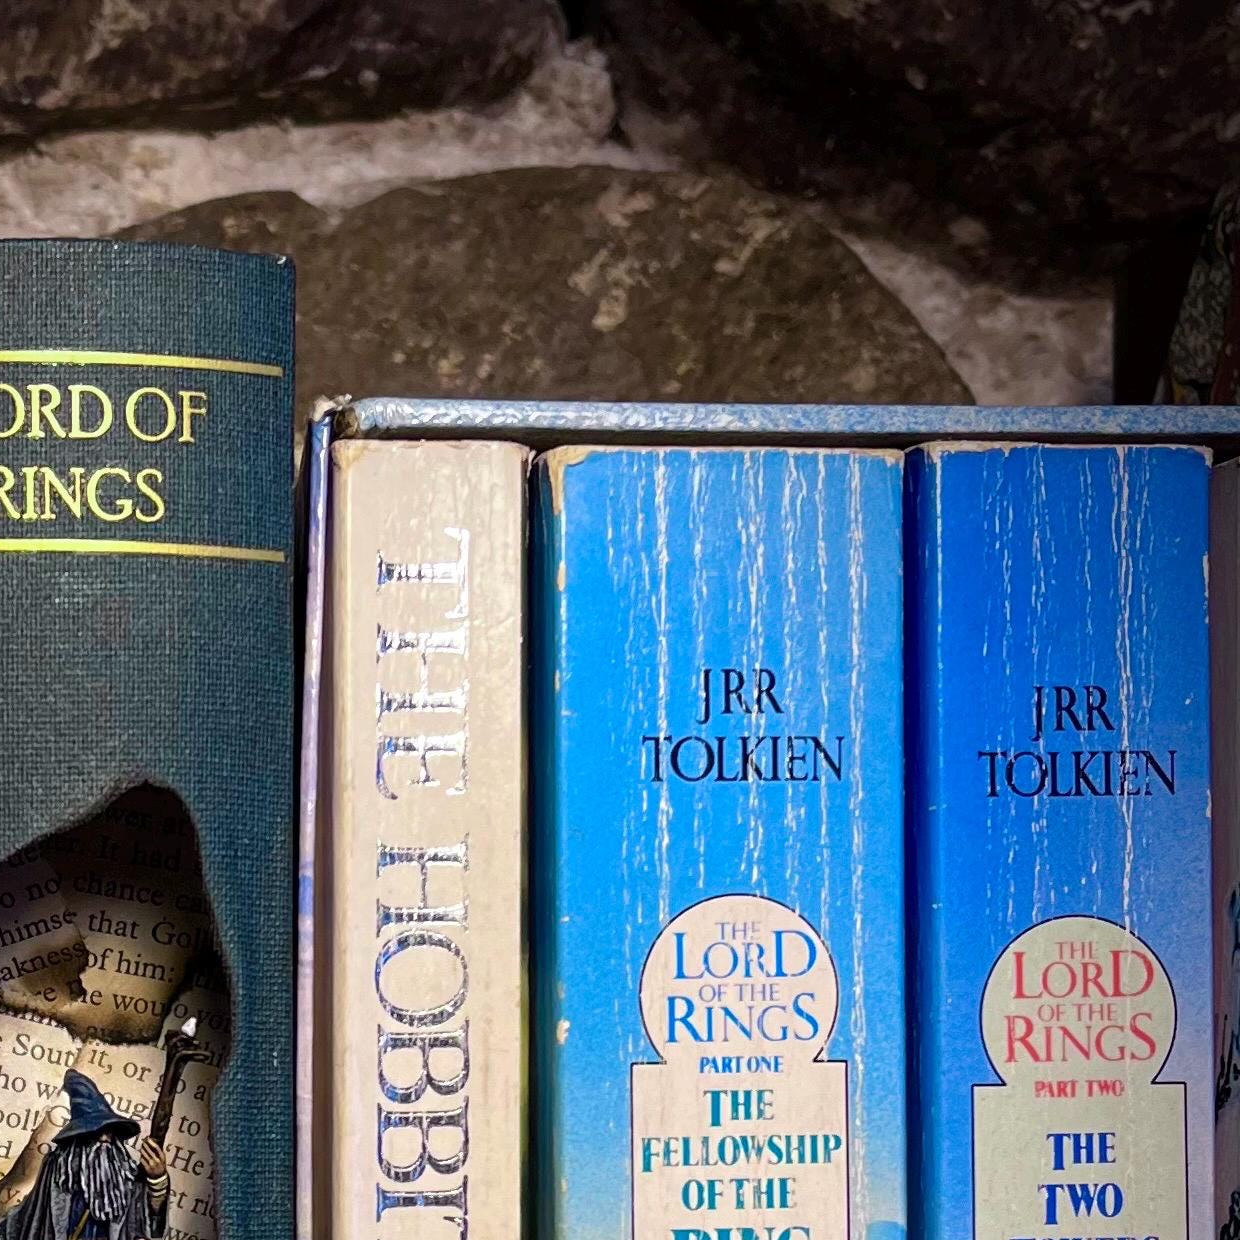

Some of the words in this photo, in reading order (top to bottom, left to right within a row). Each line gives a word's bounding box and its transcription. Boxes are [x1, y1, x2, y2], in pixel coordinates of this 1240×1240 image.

[125, 387, 208, 443] OF
[376, 527, 471, 800] THE
[696, 667, 784, 725] JRR
[1031, 684, 1115, 742] JRR
[642, 735, 845, 782] TOLKIEN
[977, 750, 1177, 798] TOLKIEN
[88, 910, 140, 940] that
[714, 920, 762, 942] THE
[115, 951, 175, 983] him:
[672, 929, 817, 981] LORD
[1055, 941, 1098, 961] THE
[698, 983, 725, 1003] OF
[732, 983, 781, 1002] THE
[1010, 949, 1155, 999] LORD
[665, 992, 821, 1045] RINGS
[1038, 1002, 1065, 1023] OF
[1070, 1002, 1117, 1022] THE
[1003, 1012, 1157, 1064] RINGS
[123, 1061, 152, 1083] or
[698, 1055, 745, 1075] PART
[748, 1055, 784, 1073] ONE
[703, 1089, 774, 1128] THE
[1034, 1081, 1080, 1098] PART
[1085, 1080, 1125, 1097] TWO
[640, 1134, 842, 1175] FELLOWSHIP
[1046, 1131, 1116, 1172] THE
[681, 1178, 724, 1212] OF
[729, 1176, 797, 1211] THE
[1038, 1183, 1123, 1225] TWO
